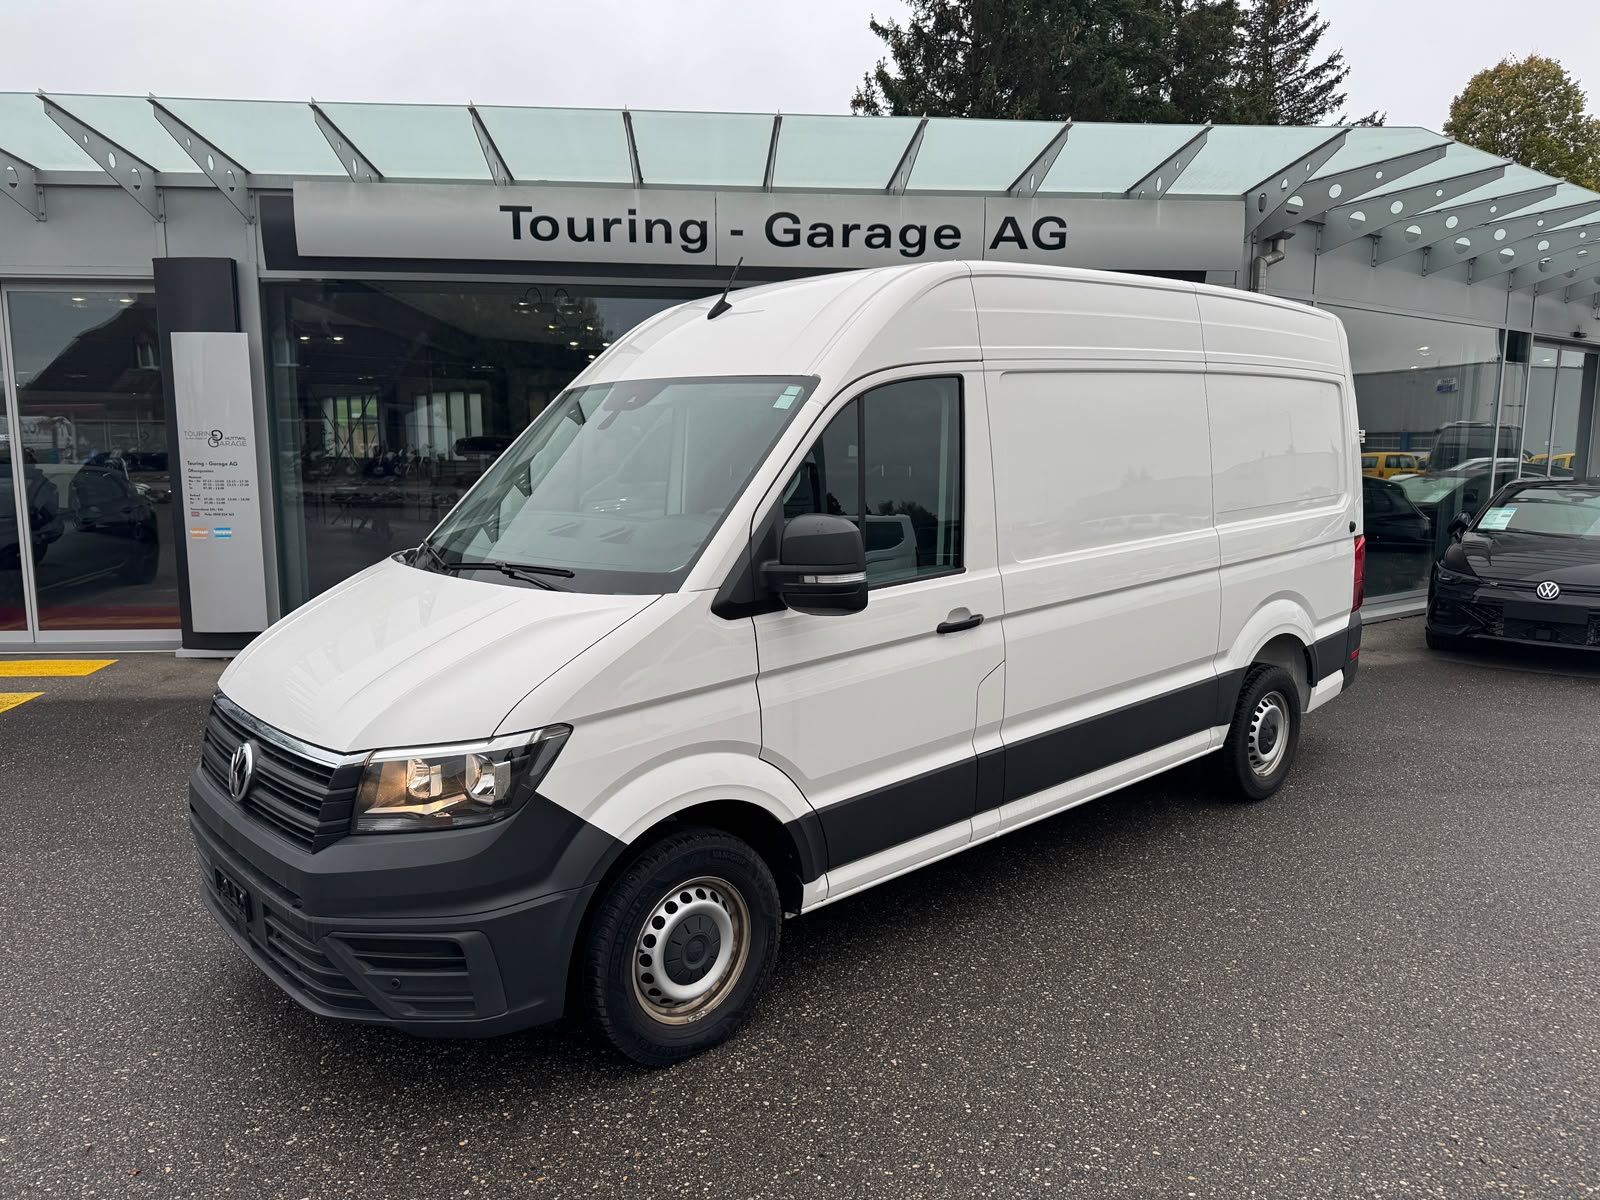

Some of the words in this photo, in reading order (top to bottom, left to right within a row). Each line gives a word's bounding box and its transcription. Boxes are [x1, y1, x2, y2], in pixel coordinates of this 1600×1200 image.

[500, 205, 708, 254] Touring
[764, 211, 962, 258] Garage
[988, 215, 1067, 251] AG
[187, 460, 205, 468] Touring
[208, 460, 228, 468] Garage
